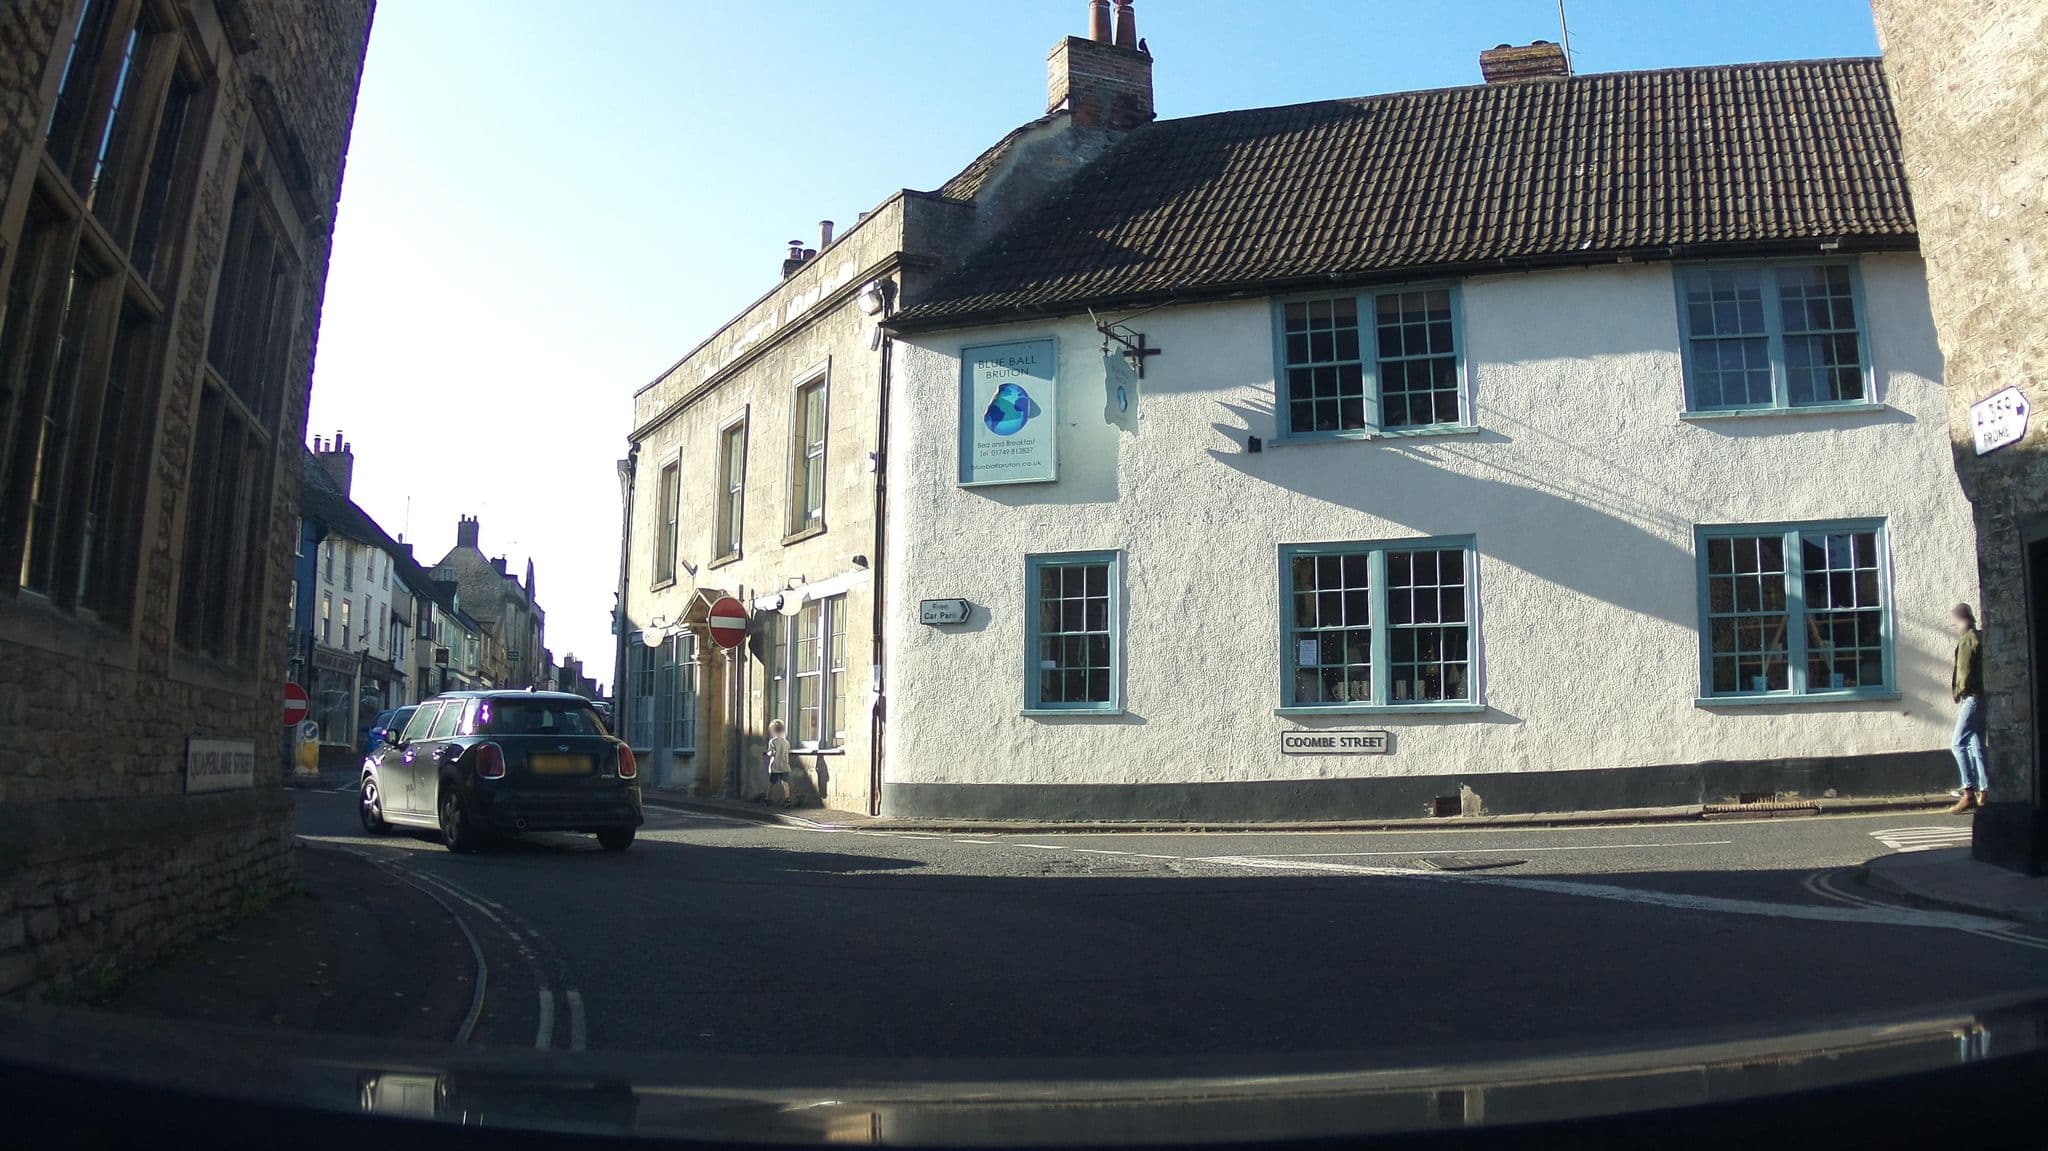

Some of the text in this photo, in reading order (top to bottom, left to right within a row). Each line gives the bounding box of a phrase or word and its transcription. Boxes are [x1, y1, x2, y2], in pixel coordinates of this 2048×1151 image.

[978, 355, 1037, 369] BLUE BALL
[986, 368, 1029, 380] BRUTON
[991, 440, 1005, 448] and
[1006, 438, 1036, 447] Breakfast
[924, 612, 937, 620] Car
[1285, 736, 1385, 747] COOMBE STREET
[234, 752, 253, 775] STREET
